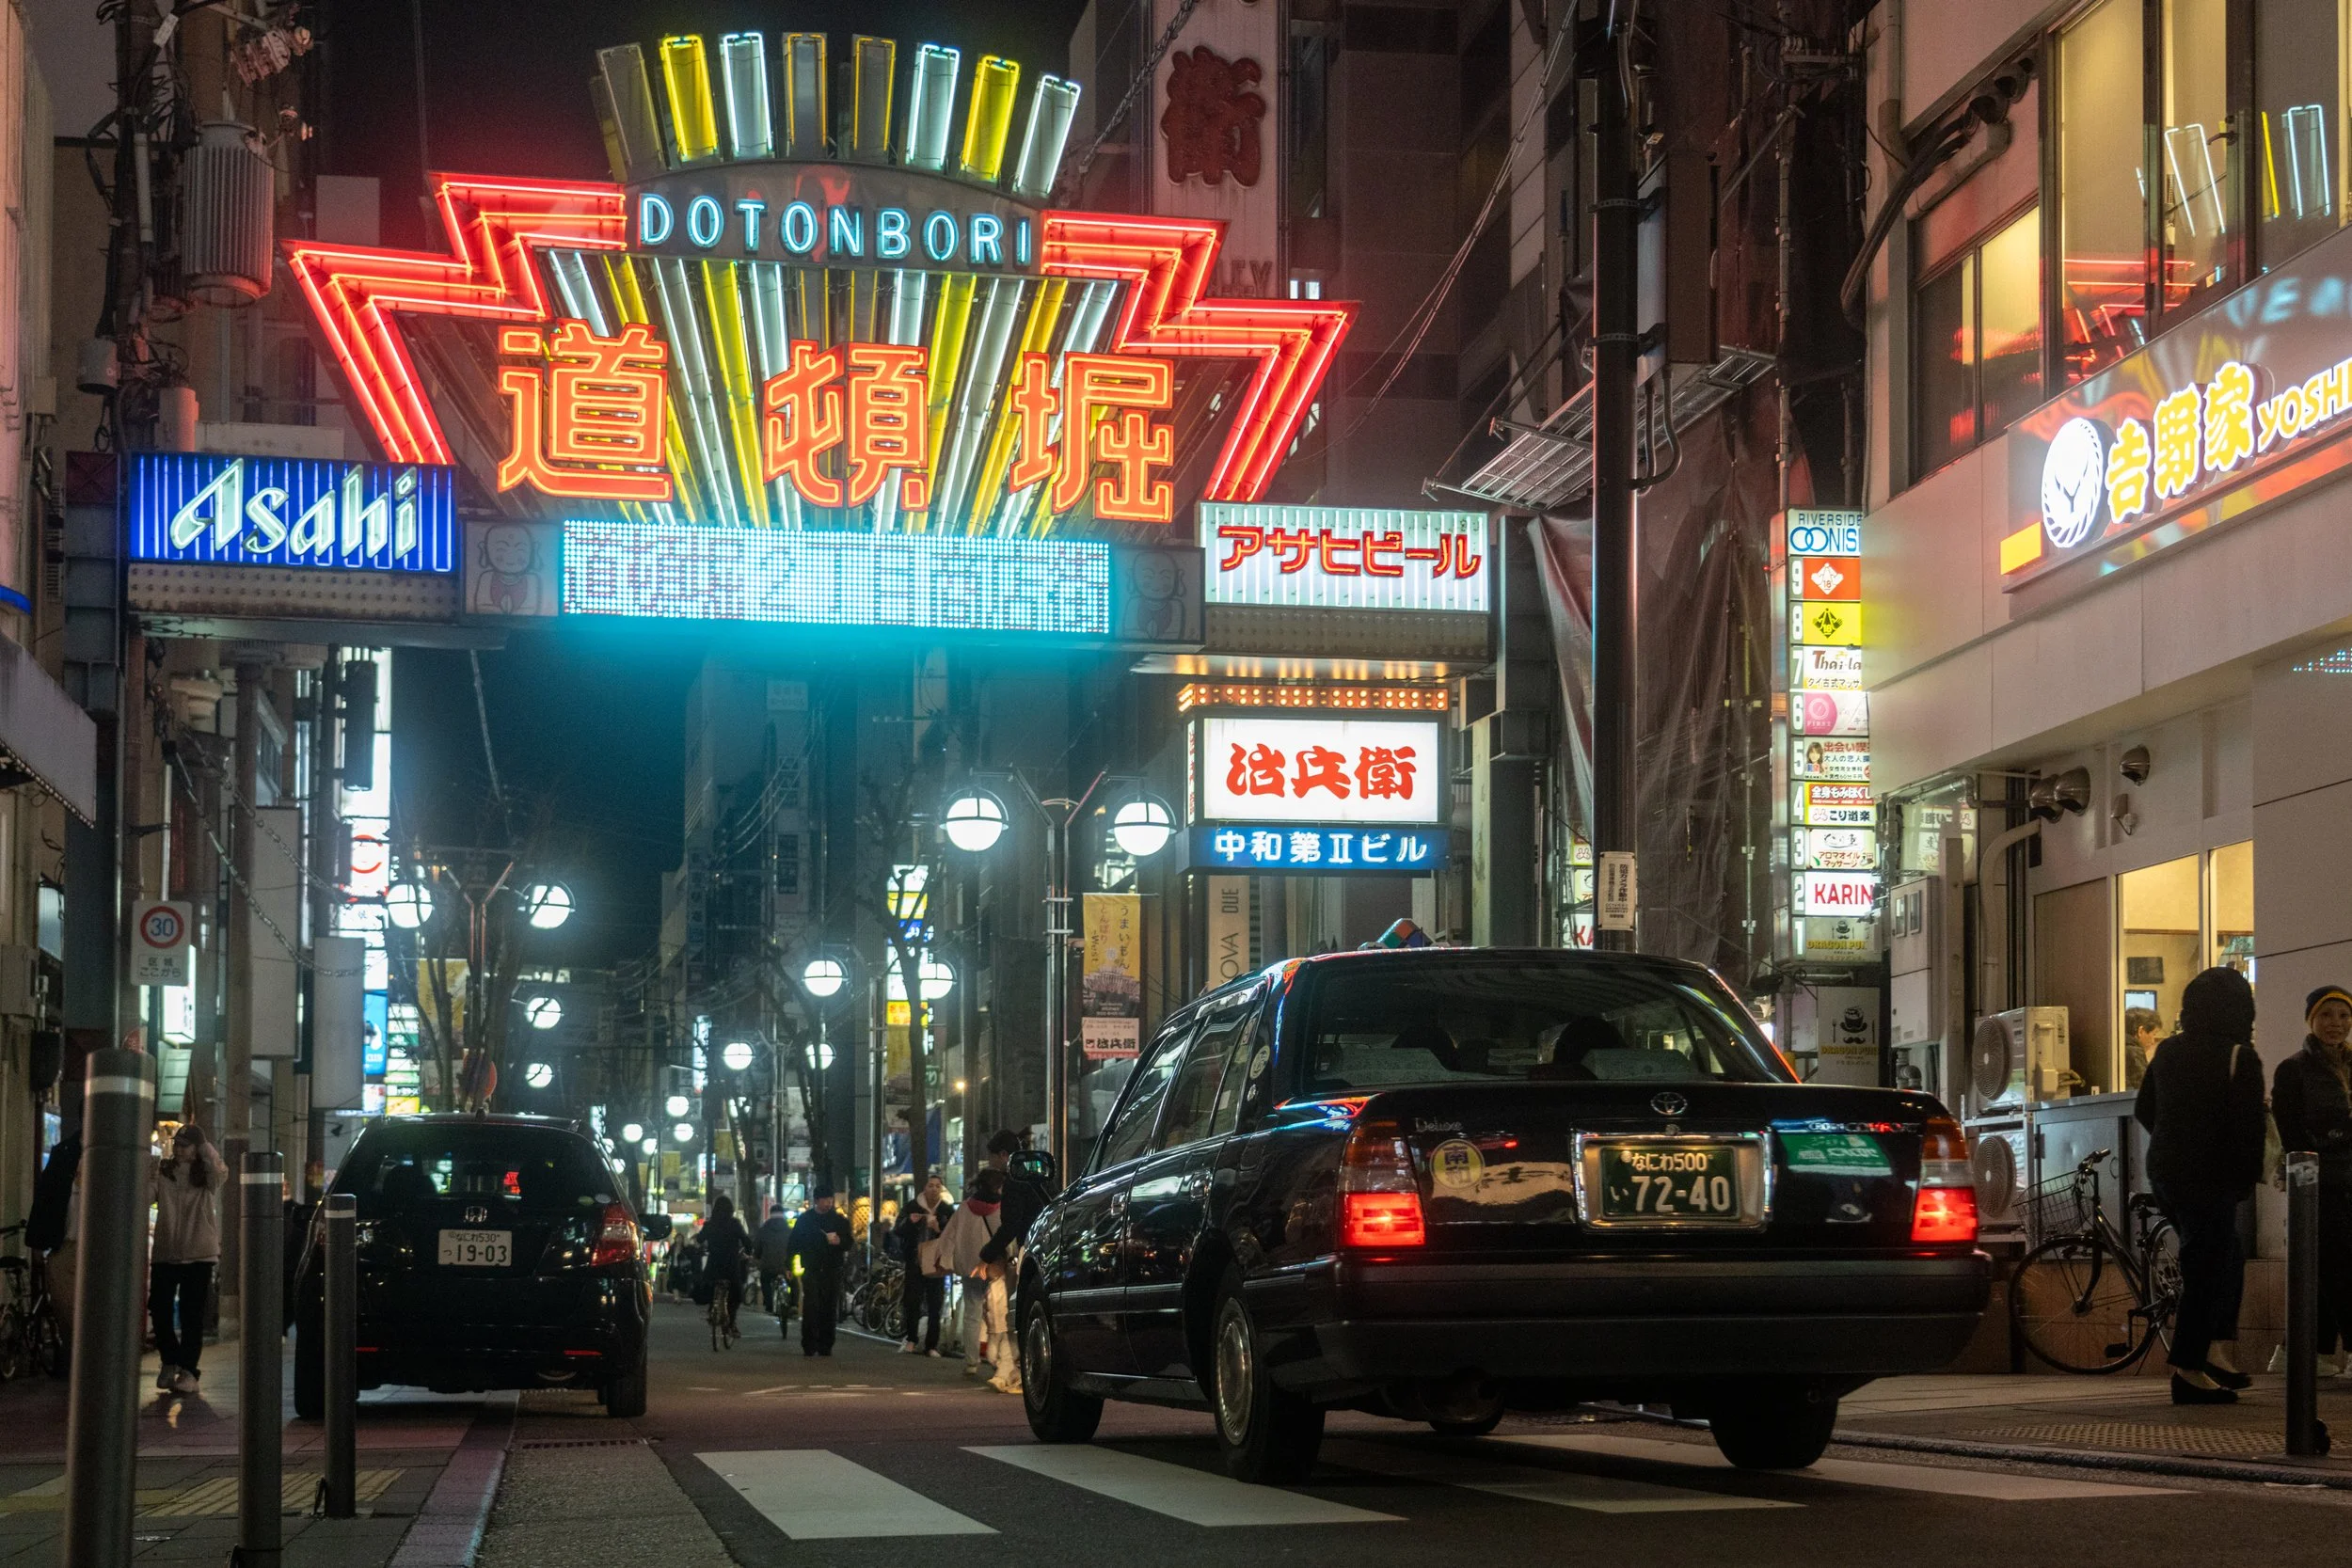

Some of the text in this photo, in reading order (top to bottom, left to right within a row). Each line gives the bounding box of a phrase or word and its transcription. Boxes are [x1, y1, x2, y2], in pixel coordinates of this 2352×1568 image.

[640, 193, 1031, 267] DOTONBORI
[498, 319, 1174, 524] 道頓堀
[2106, 362, 2255, 523] 吉野家
[170, 458, 418, 560] Asahi
[1218, 525, 1482, 578] アサヒビール
[1789, 526, 1862, 553] OONIS
[1791, 560, 1804, 595] 9
[1792, 605, 1804, 641] 8
[1792, 649, 1804, 686] 7
[1792, 695, 1804, 731] 6
[1226, 743, 1418, 800] 治兵衛
[1793, 740, 1804, 776] 5
[1793, 785, 1804, 821] 4
[1794, 829, 1804, 865] 3
[1221, 888, 1240, 914] DUE
[1794, 875, 1804, 911] 2
[1814, 883, 1874, 905] KARIN
[151, 917, 174, 937] 30
[1794, 920, 1804, 956] 1
[1220, 932, 1239, 984] OVA
[1415, 1117, 1463, 1132] Deluxe
[1631, 1151, 1708, 1172] なにわ500
[1630, 1175, 1731, 1212] 72-40
[456, 1243, 508, 1263] 19-03
